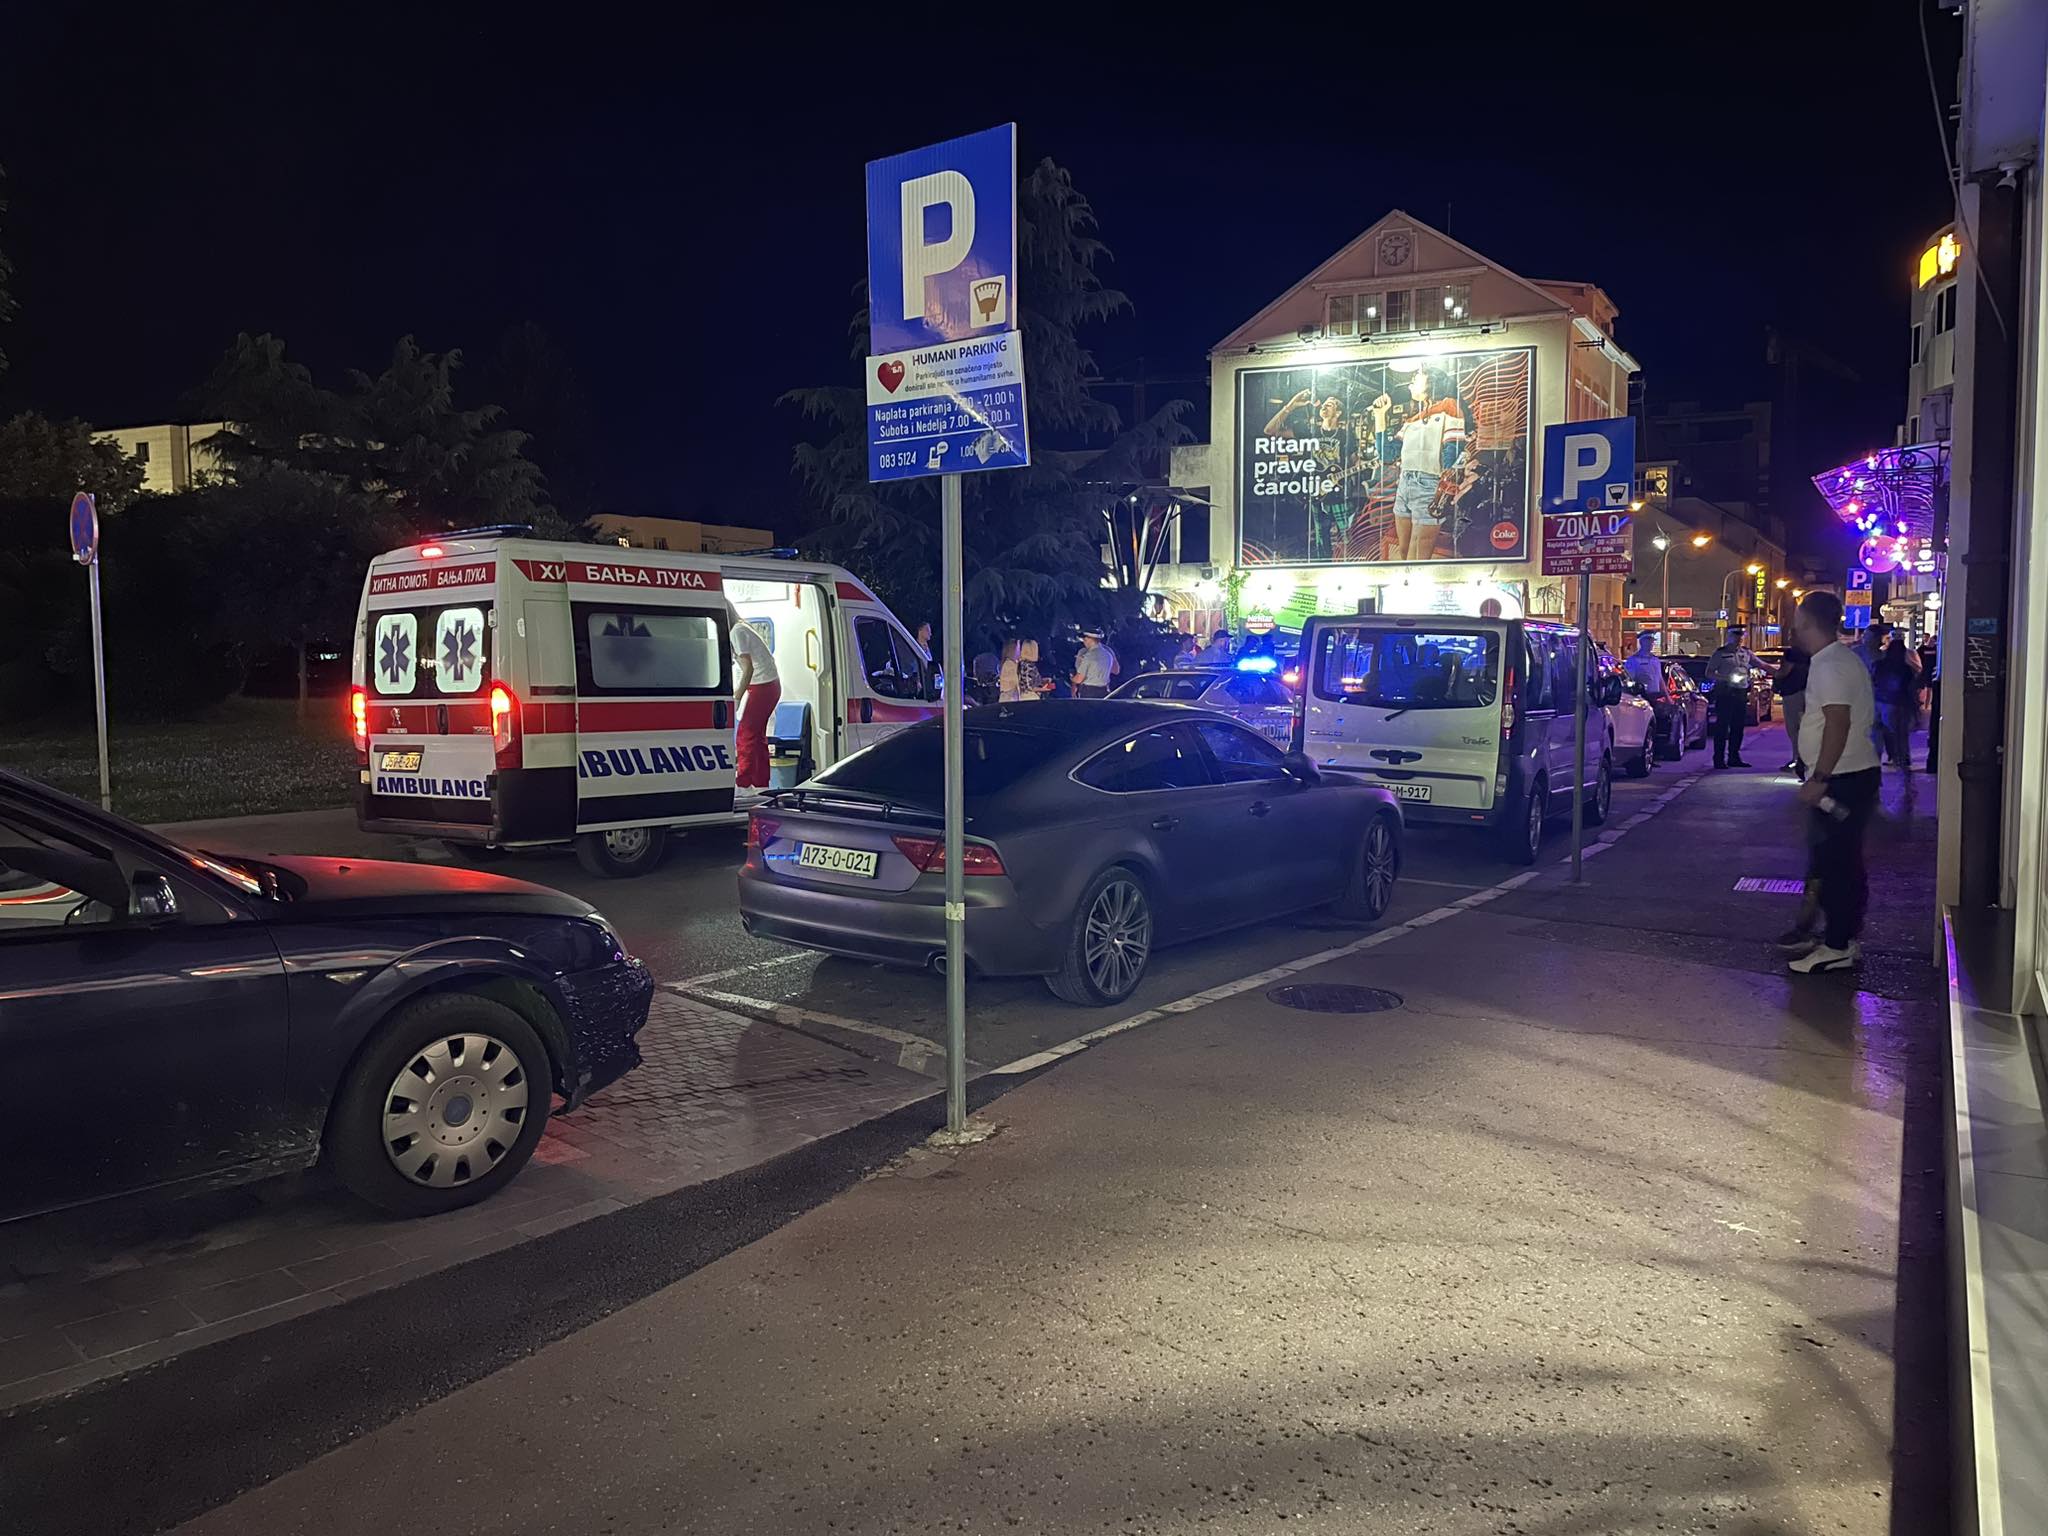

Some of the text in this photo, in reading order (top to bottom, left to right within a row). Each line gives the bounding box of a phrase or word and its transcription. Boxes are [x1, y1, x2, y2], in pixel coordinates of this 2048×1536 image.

[901, 169, 976, 320] P
[912, 340, 1007, 366] HUMANI PARKING
[875, 407, 907, 423] Naplata
[909, 401, 952, 420] parkiranja
[984, 394, 1007, 406] 21.00
[1008, 392, 1015, 403] h
[880, 424, 909, 438] Subota
[911, 422, 915, 434] i
[916, 418, 947, 434] Nedelja
[949, 415, 970, 429] 7.00
[1005, 409, 1011, 421] h
[1255, 436, 1320, 455] Ritam
[880, 451, 917, 469] 083 5124
[1254, 459, 1317, 479] prave
[1563, 433, 1611, 501] P
[1253, 475, 1340, 497] čarolije.
[1556, 516, 1602, 538] ZONA
[372, 567, 487, 593] ХИТНА ПОМОЋ БАЊА ЛУКА
[585, 565, 651, 585] БАЊА
[656, 570, 706, 589] ЛУКА
[1852, 571, 1867, 588] P
[1756, 571, 1766, 609] HOTEL
